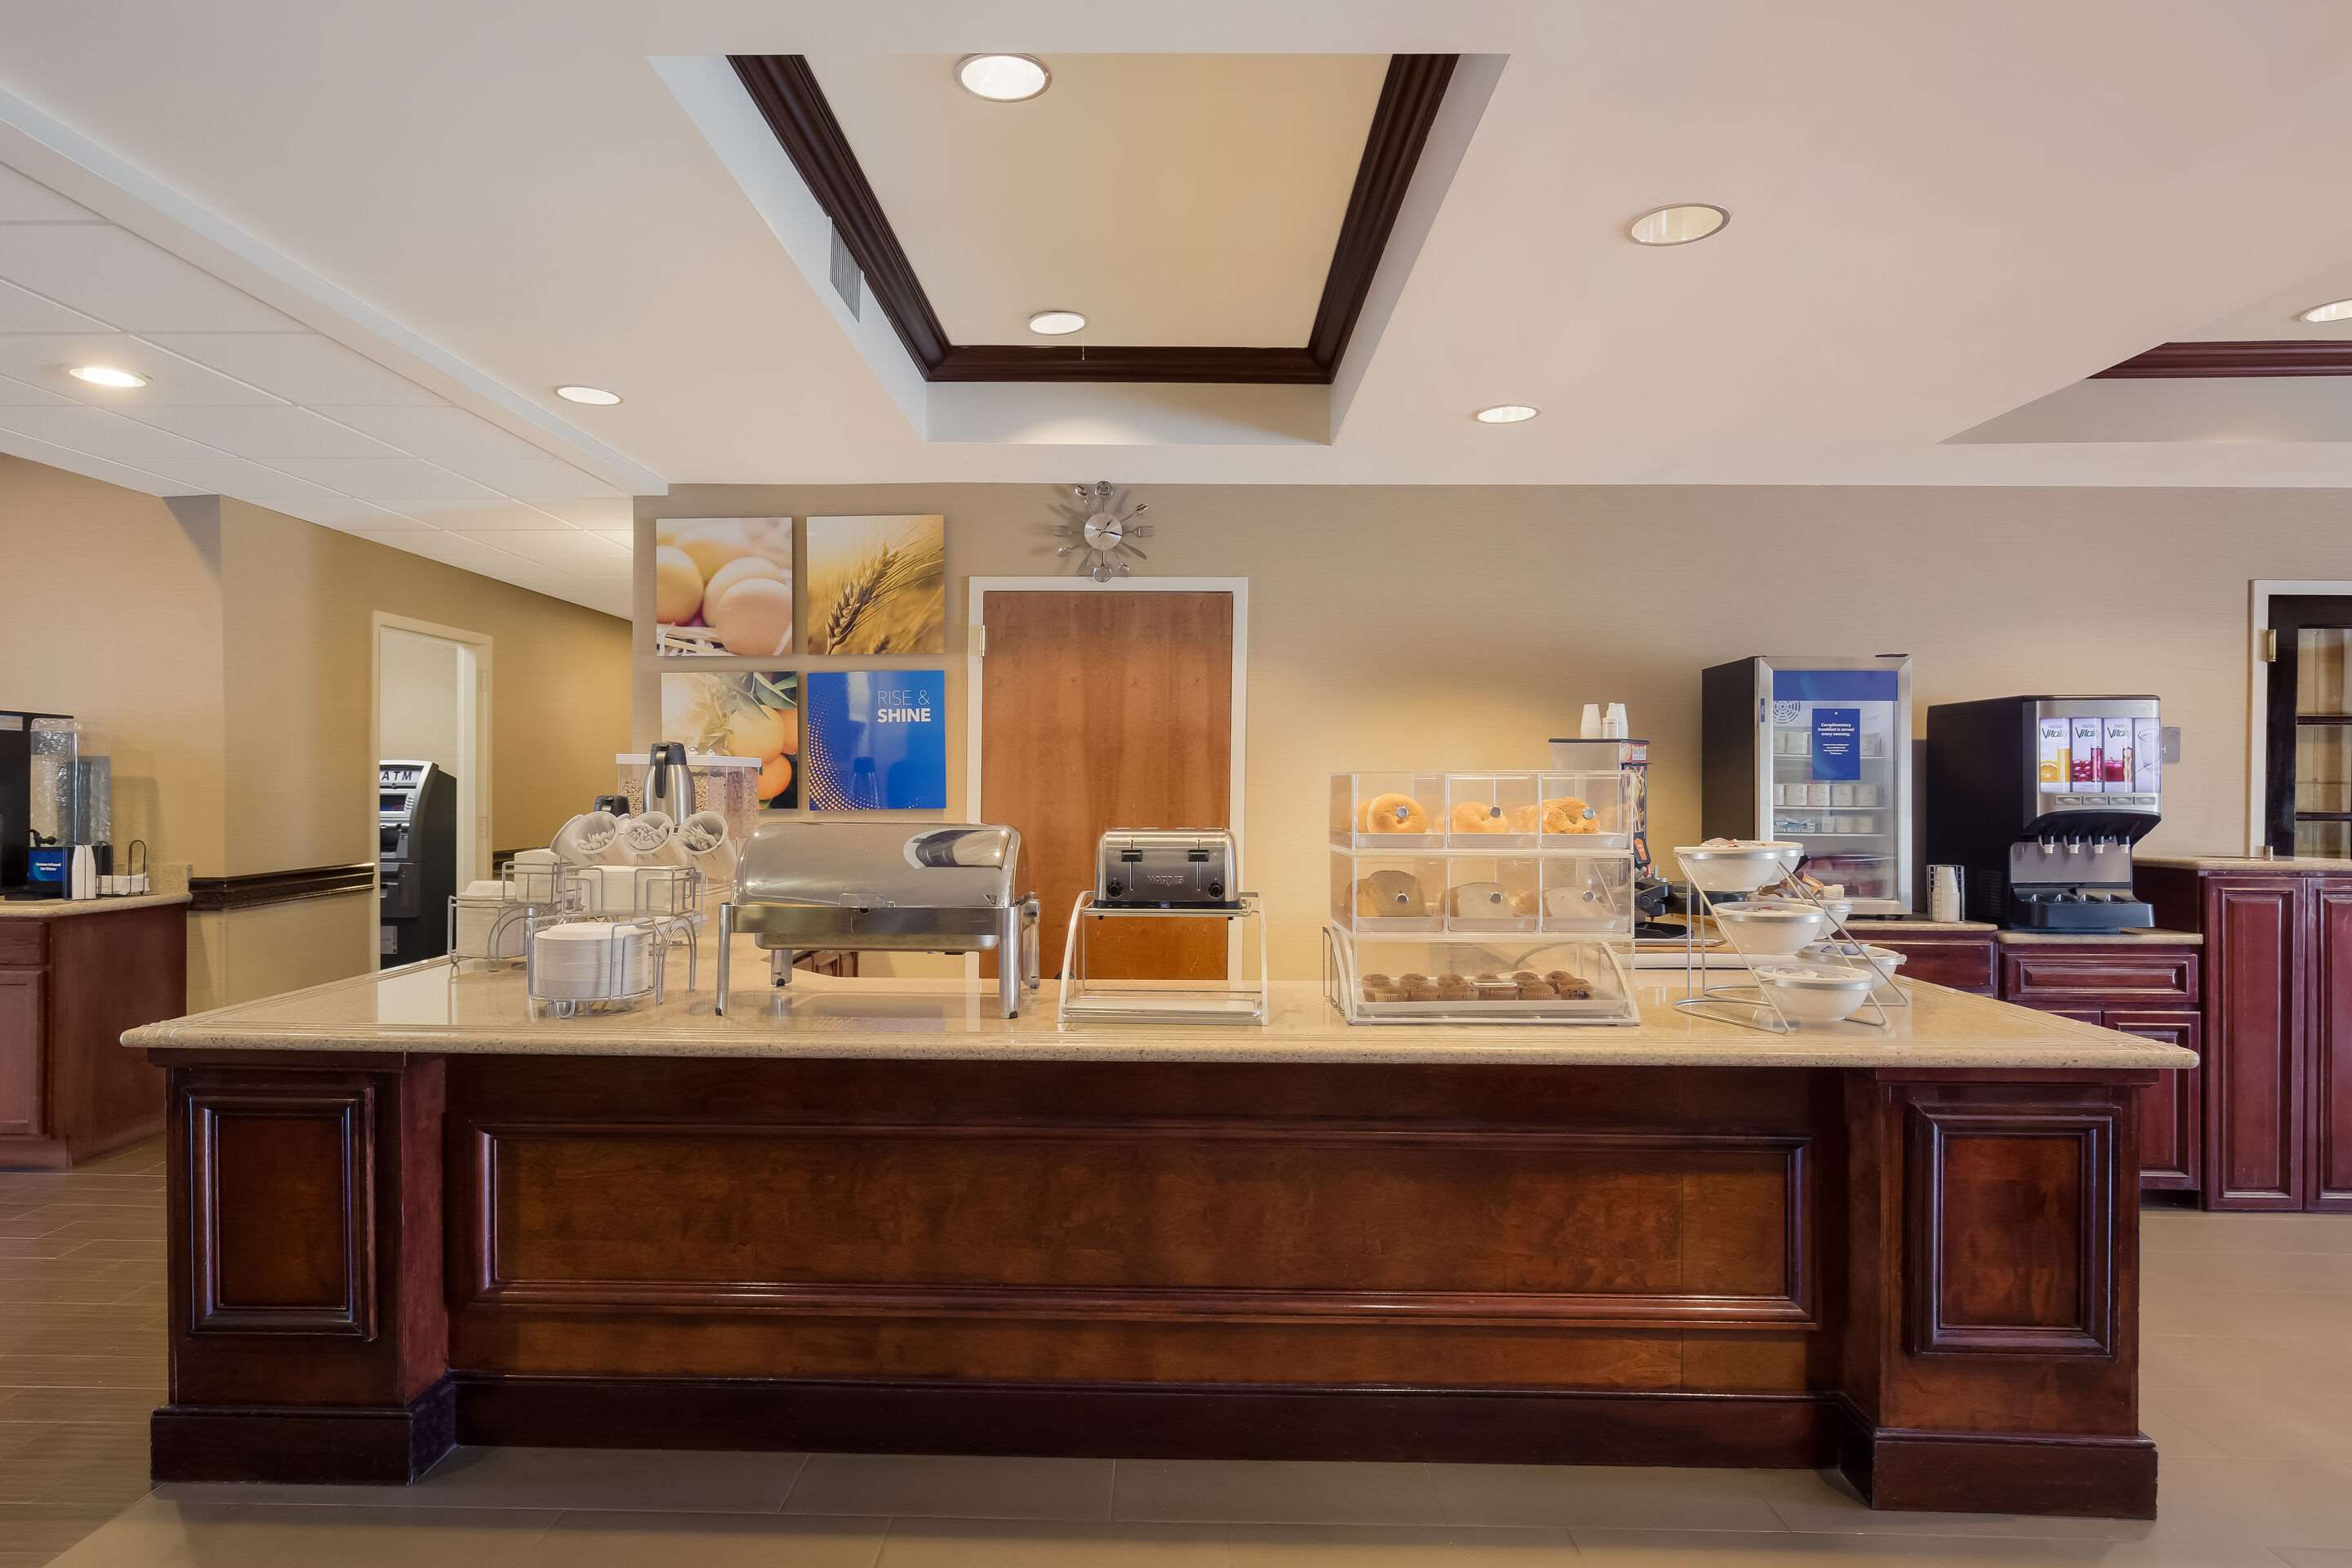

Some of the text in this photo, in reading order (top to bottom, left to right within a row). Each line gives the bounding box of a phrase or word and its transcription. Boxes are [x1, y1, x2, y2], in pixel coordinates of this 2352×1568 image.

[878, 689, 931, 706] RISE &
[876, 708, 932, 724] SHINE
[2074, 726, 2100, 739] Vitaly
[381, 770, 412, 782] ATM
